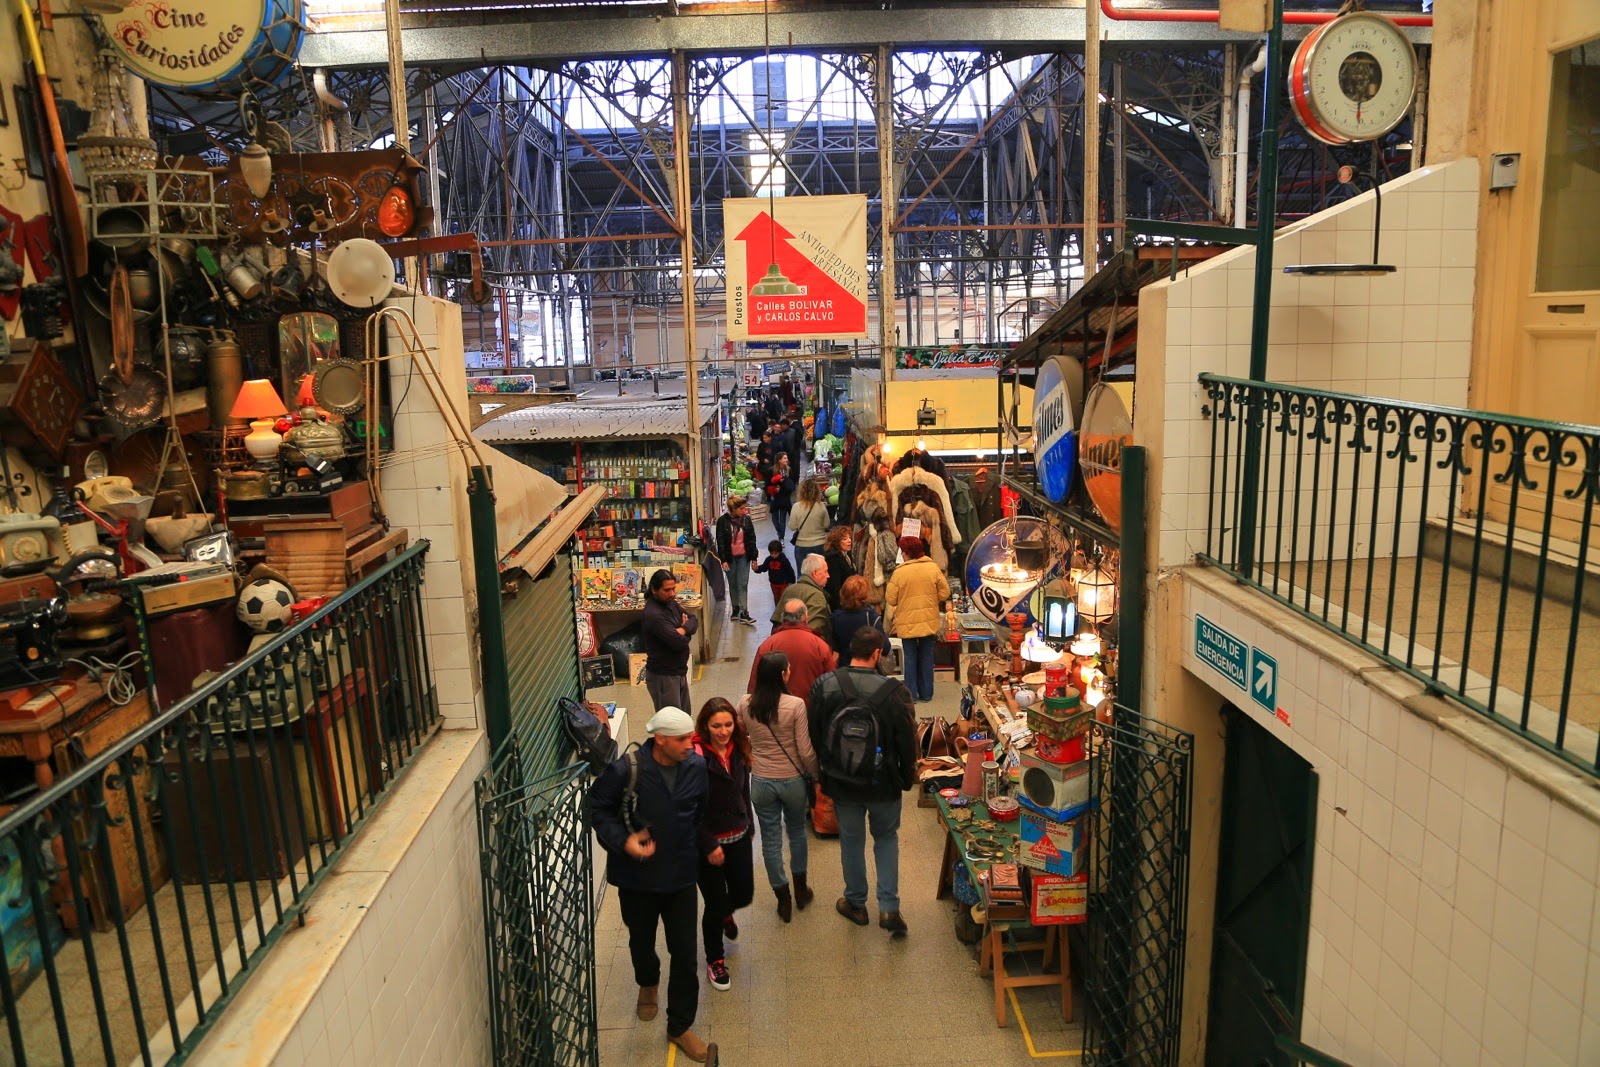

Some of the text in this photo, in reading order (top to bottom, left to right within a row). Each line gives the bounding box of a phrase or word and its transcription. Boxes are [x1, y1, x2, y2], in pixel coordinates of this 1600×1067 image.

[153, 8, 208, 29] Cine
[121, 23, 245, 71] Curiosidades
[798, 229, 863, 284] ANTIGUEDADES
[734, 285, 743, 326] Puestos
[756, 299, 833, 311] Calles BOLIVAR
[757, 311, 834, 324] y CARLOS CALVO
[932, 350, 966, 369] Julia
[744, 375, 758, 385] 54
[1202, 624, 1240, 660] SALIDA DE
[1197, 639, 1245, 684] EMERGENCIA
